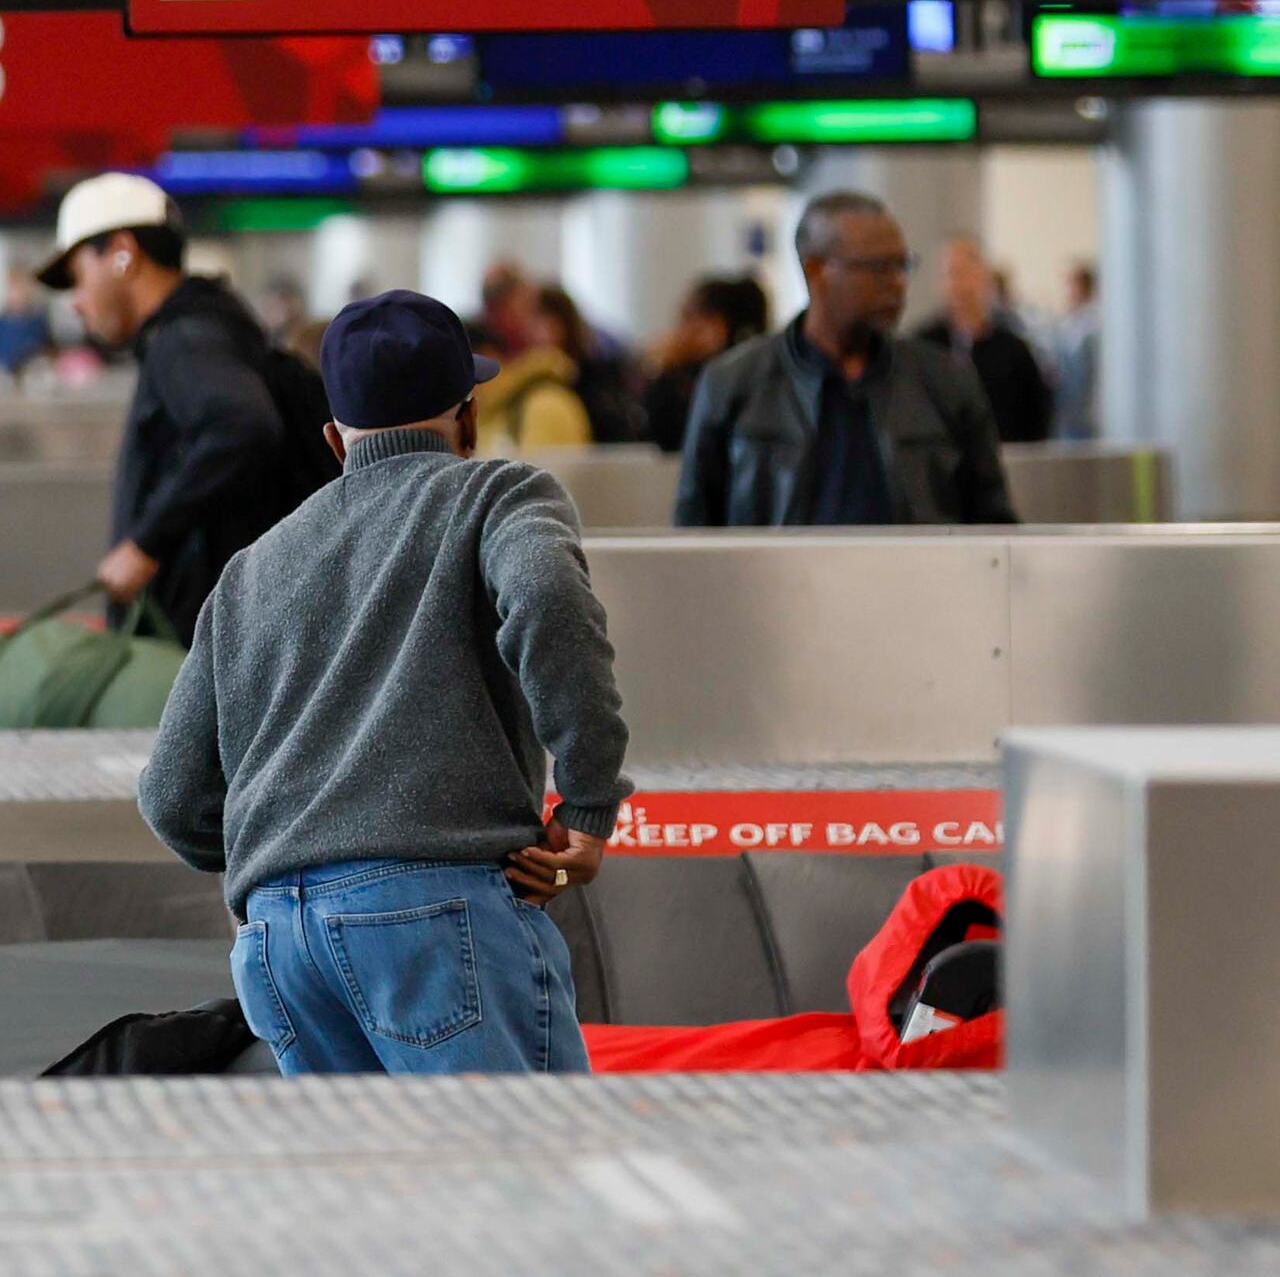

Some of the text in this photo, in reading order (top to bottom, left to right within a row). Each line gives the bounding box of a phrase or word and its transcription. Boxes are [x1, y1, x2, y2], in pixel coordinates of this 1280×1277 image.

[606, 823, 718, 847] KEEP
[729, 822, 813, 847] OFF
[825, 822, 920, 847] BAG
